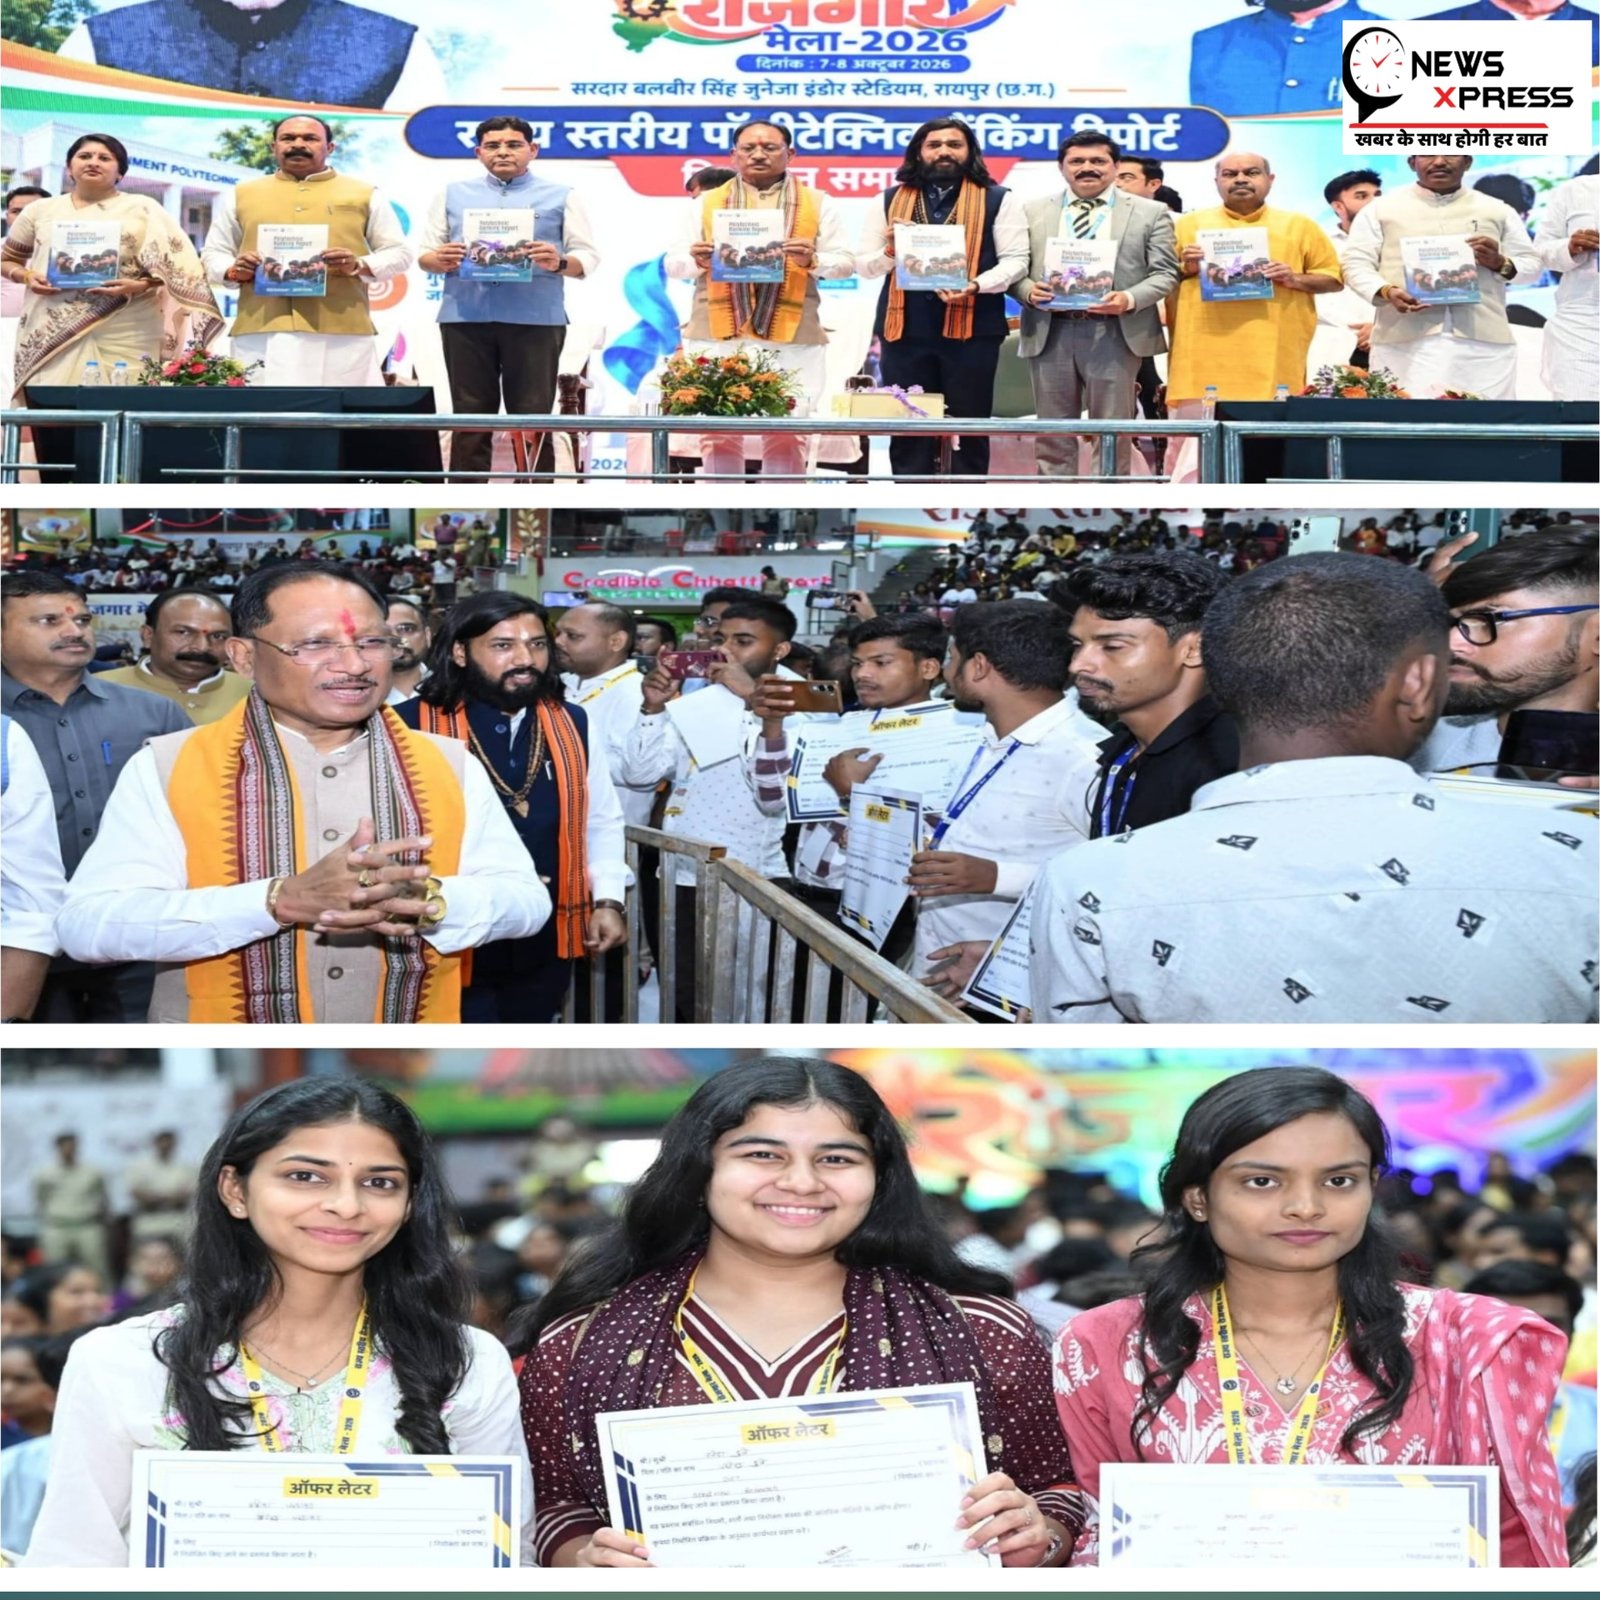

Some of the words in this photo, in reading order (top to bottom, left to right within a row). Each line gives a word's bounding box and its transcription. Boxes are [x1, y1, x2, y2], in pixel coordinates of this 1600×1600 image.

[755, 56, 804, 70] दिनांक
[820, 58, 847, 69] 7-8
[910, 58, 952, 70] 2026
[571, 80, 627, 95] सरदार
[634, 78, 695, 96] बलबीर
[702, 78, 736, 96] सिंह
[743, 79, 798, 99] जुनेजा
[804, 78, 846, 97] इंडोर
[934, 83, 990, 100] रायपुर
[565, 111, 691, 150] स्तरीय
[563, 570, 662, 589] Credible
[748, 1424, 790, 1441] ऑफर
[796, 1422, 829, 1437] लेटर
[289, 1481, 333, 1496] ऑफर
[338, 1480, 373, 1496] लेटर
